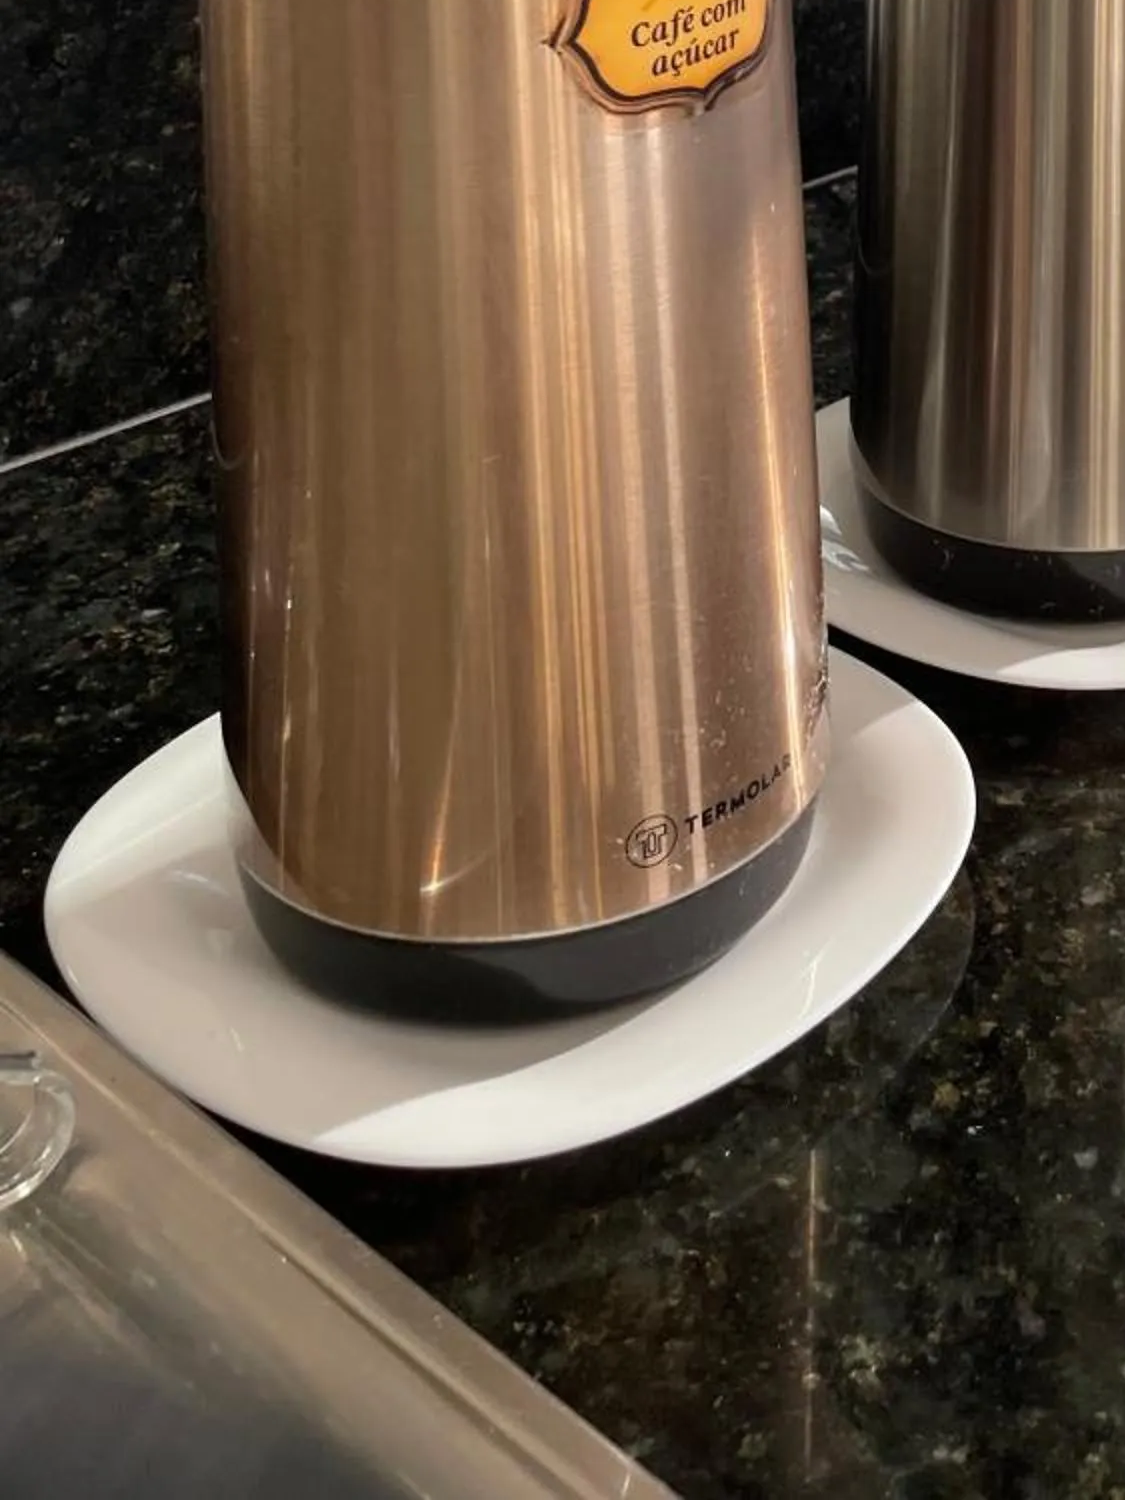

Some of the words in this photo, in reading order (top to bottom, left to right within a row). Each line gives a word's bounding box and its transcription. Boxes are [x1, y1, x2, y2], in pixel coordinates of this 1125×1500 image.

[631, 5, 695, 48] Café
[651, 28, 740, 77] açúcar
[684, 753, 792, 835] TERMOLAR
